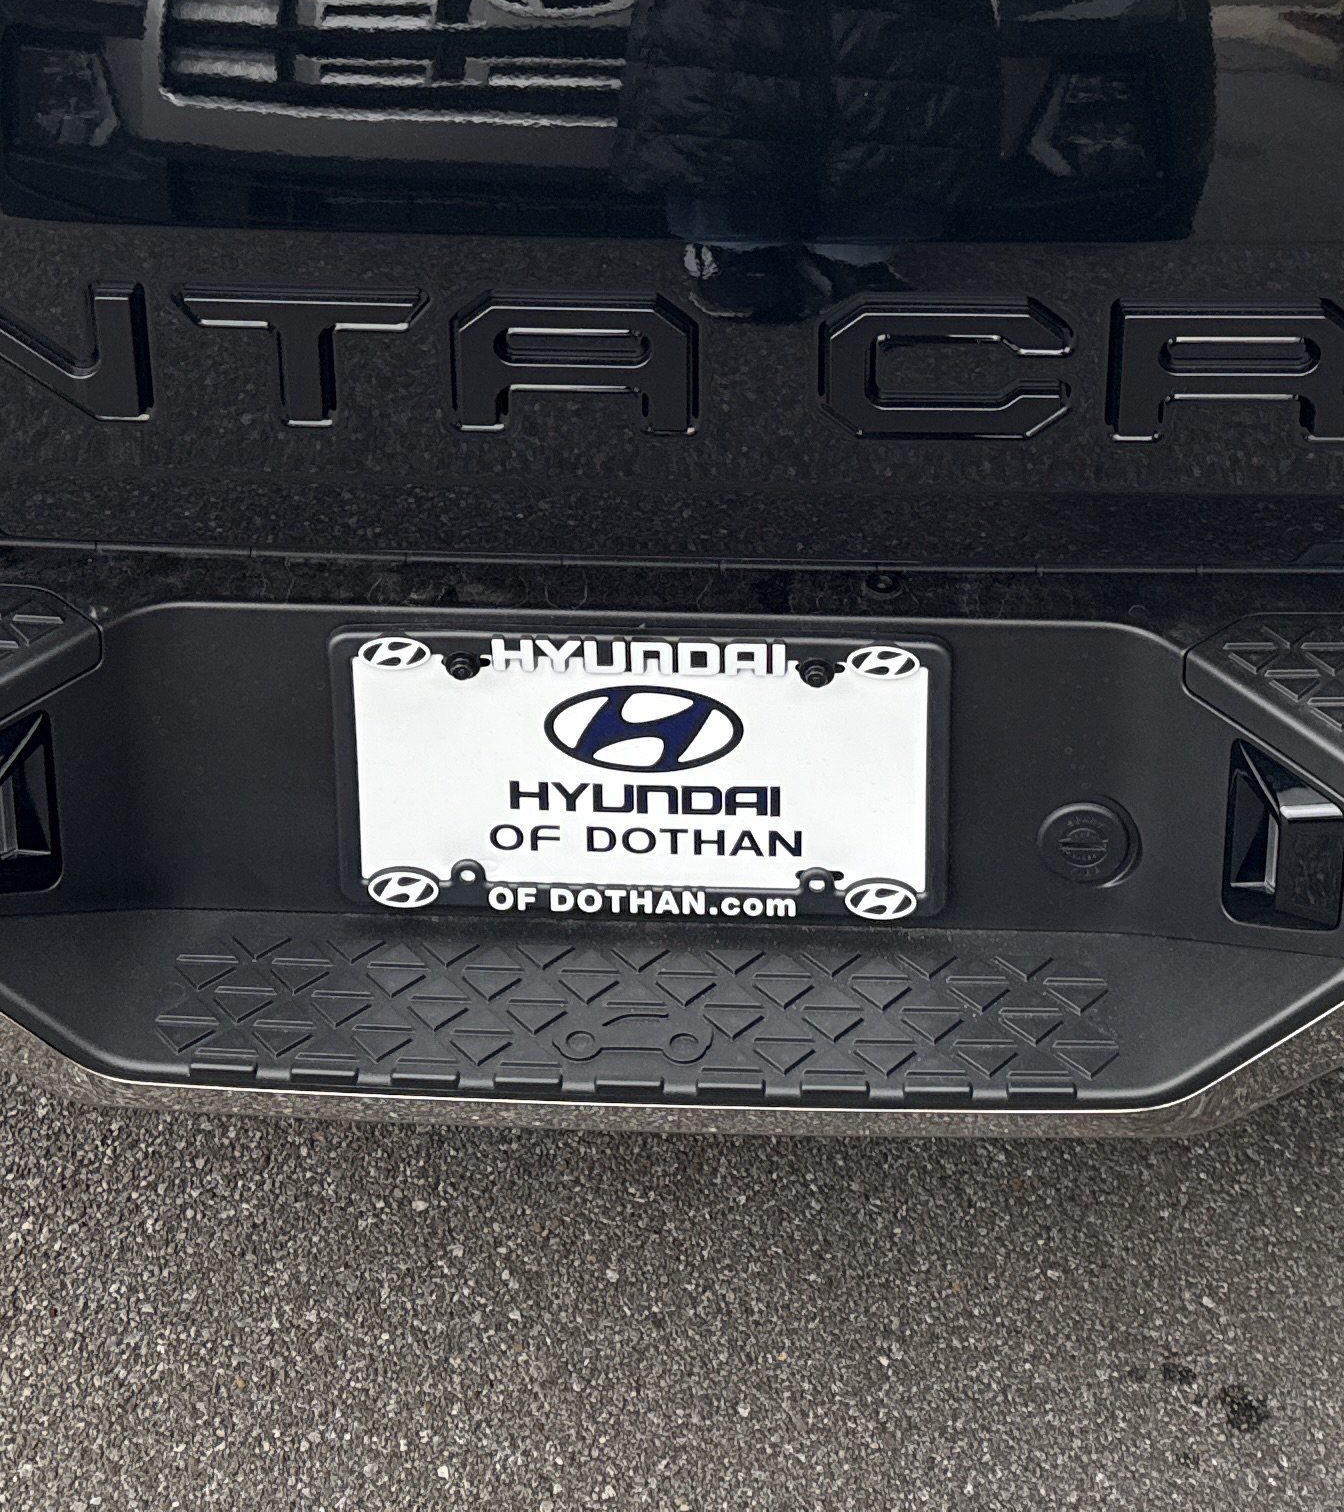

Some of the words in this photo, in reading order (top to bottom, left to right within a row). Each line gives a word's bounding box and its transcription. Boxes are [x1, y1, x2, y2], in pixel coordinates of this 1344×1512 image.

[491, 635, 788, 676] HYUNDAI
[509, 779, 782, 818] HYUNDAI
[489, 824, 561, 852] OF
[586, 826, 804, 858] DOTHAN
[487, 885, 537, 913] OF
[549, 887, 798, 918] DOTHAN.com
